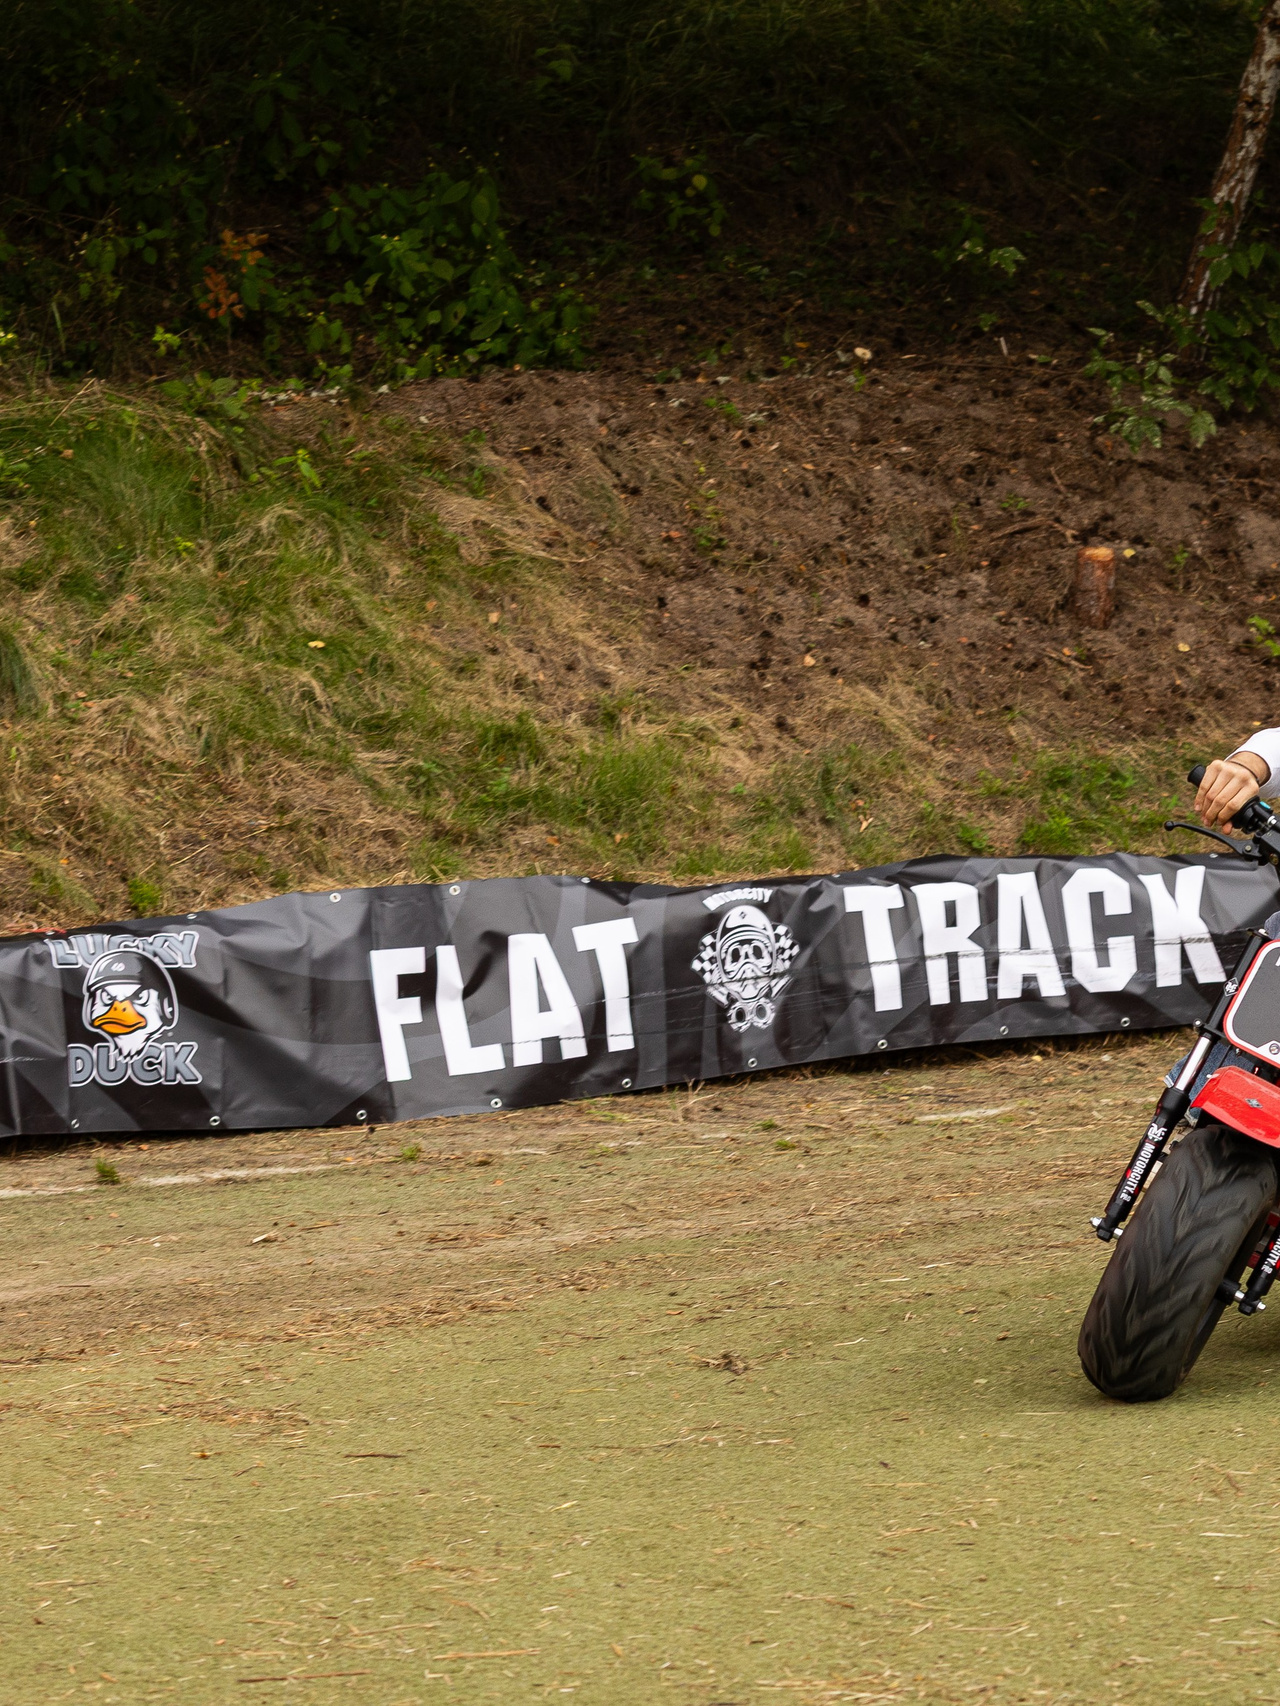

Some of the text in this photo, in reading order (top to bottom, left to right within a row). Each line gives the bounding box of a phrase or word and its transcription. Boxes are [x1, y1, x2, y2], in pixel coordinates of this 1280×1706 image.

[44, 931, 199, 968] LUCKY
[369, 865, 1227, 1083] FLAT TRACK
[67, 1042, 203, 1087] DUCK
